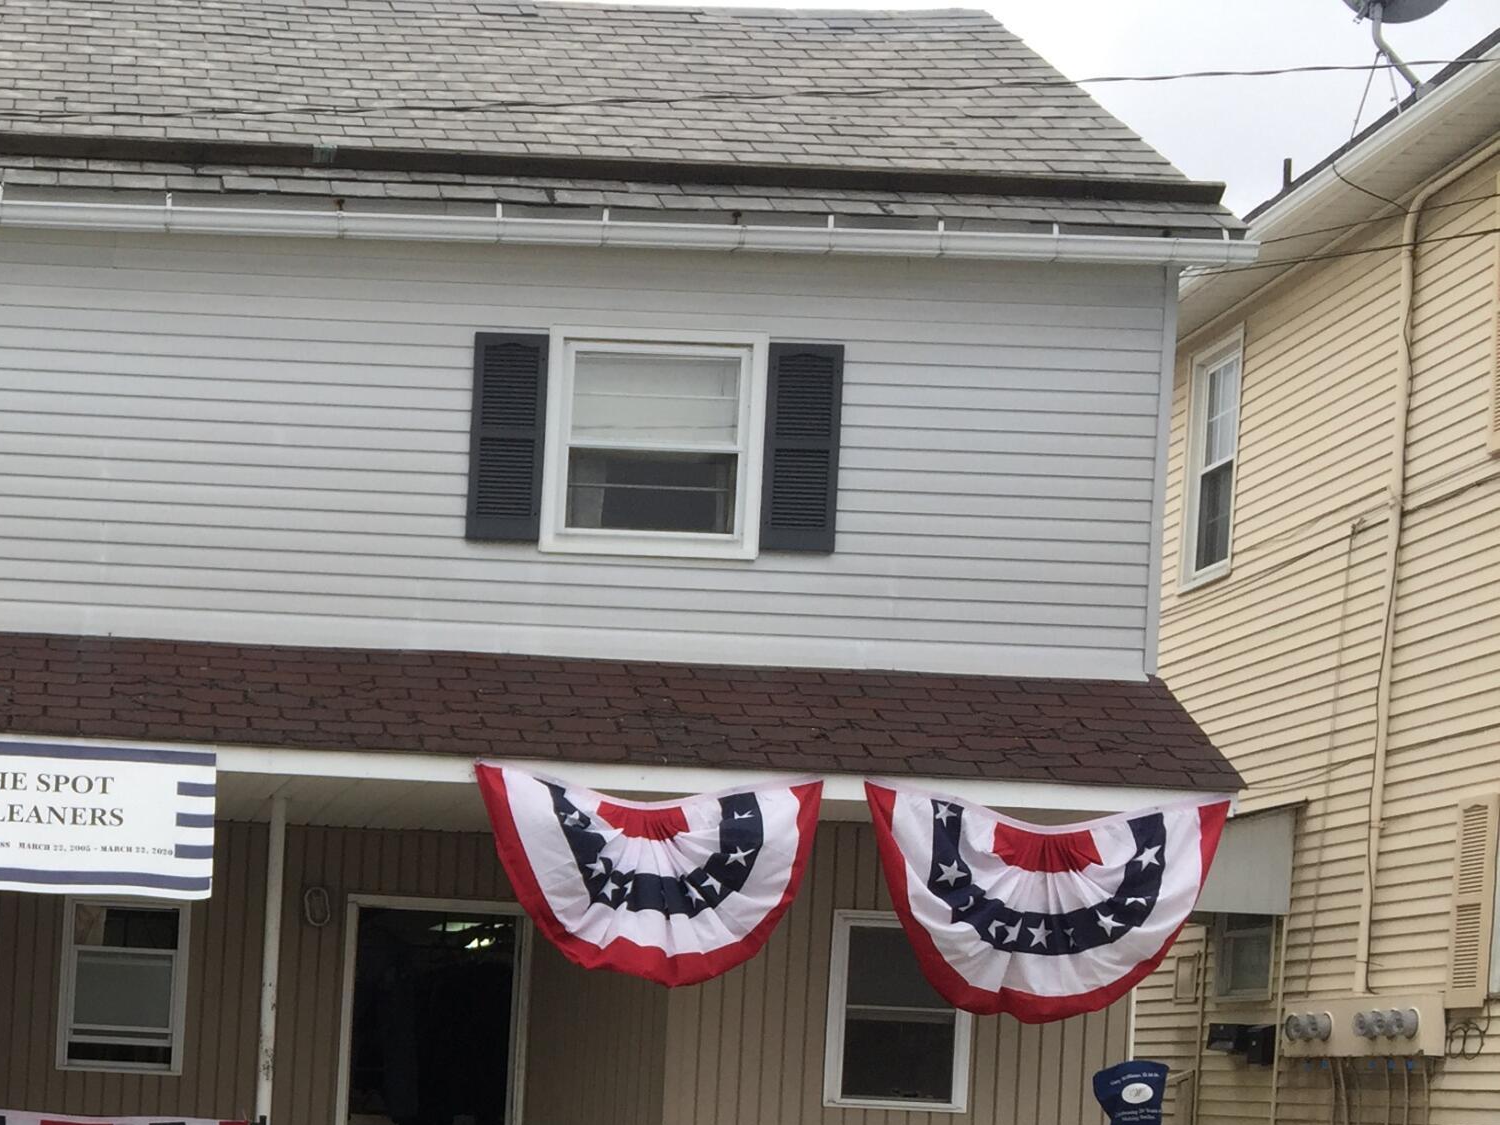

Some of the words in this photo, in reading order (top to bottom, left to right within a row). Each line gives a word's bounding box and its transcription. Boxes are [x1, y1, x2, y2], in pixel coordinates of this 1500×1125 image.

[36, 773, 115, 795] SPOT
[18, 842, 51, 851] MARCH
[100, 845, 133, 853] MARCH
[152, 847, 174, 856] 2020
